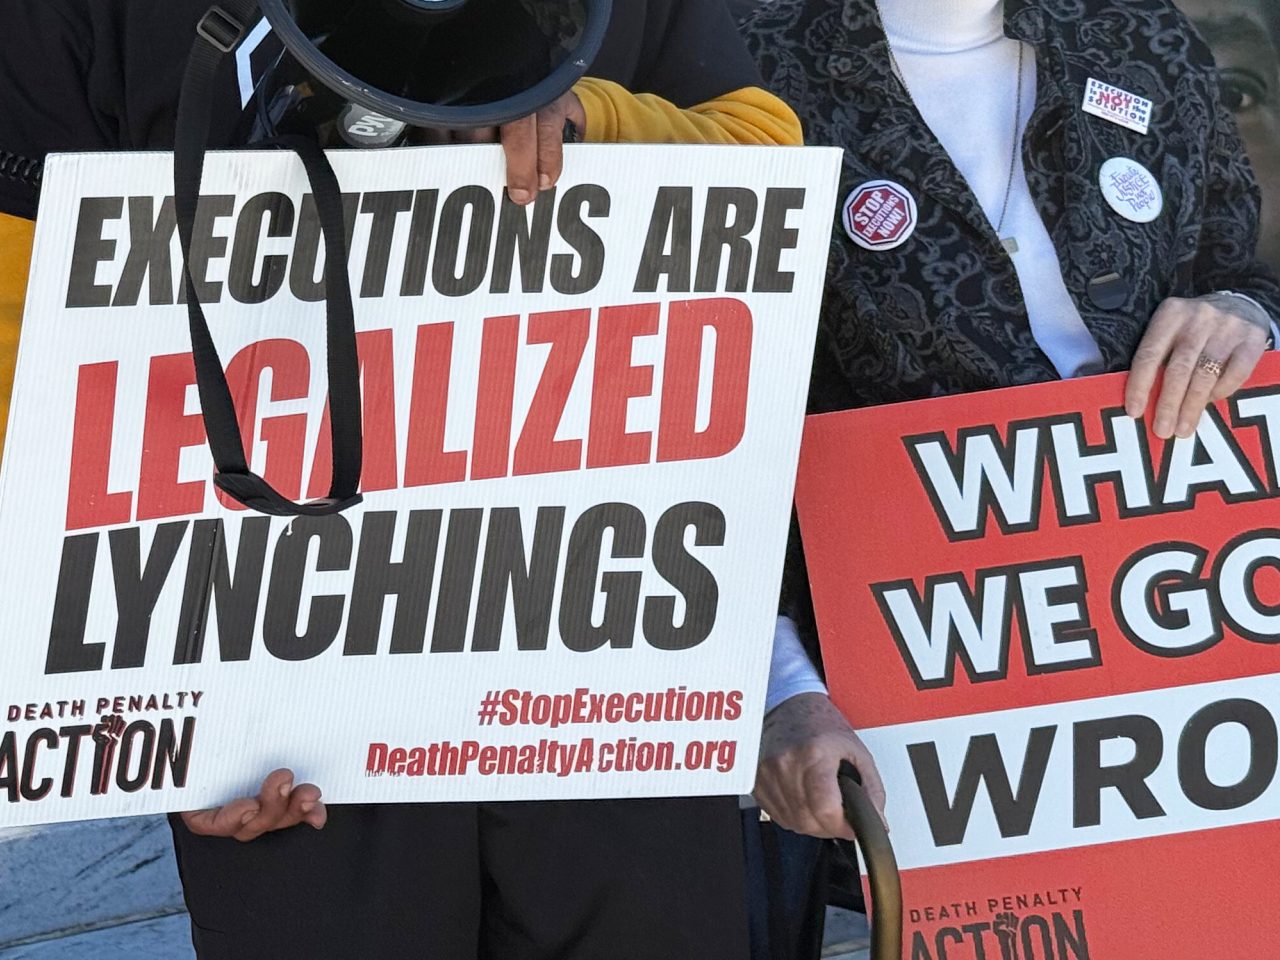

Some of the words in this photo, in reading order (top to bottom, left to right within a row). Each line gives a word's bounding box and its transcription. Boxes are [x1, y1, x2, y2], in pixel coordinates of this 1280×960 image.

[1088, 96, 1145, 123] SOLUTION
[1091, 81, 1148, 107] EXECUTION
[1099, 91, 1131, 109] NOT
[854, 191, 884, 225] STOP
[863, 195, 899, 237] EXECUTIONS
[877, 208, 905, 237] NOW!
[66, 184, 611, 308] EXECUTIONS
[634, 187, 805, 294] ARE
[66, 297, 754, 530] LEGALIZED
[44, 502, 724, 675] LYNCHINGS
[875, 559, 1100, 686] WE
[7, 699, 86, 722] DEATH
[96, 691, 204, 714] PENALTY
[477, 685, 742, 728] #StopExecutions
[365, 738, 738, 778] DeathPenaltyAction.org
[906, 697, 1280, 847] WRO
[909, 901, 978, 923] DEATH
[987, 887, 1082, 912] PENALTY
